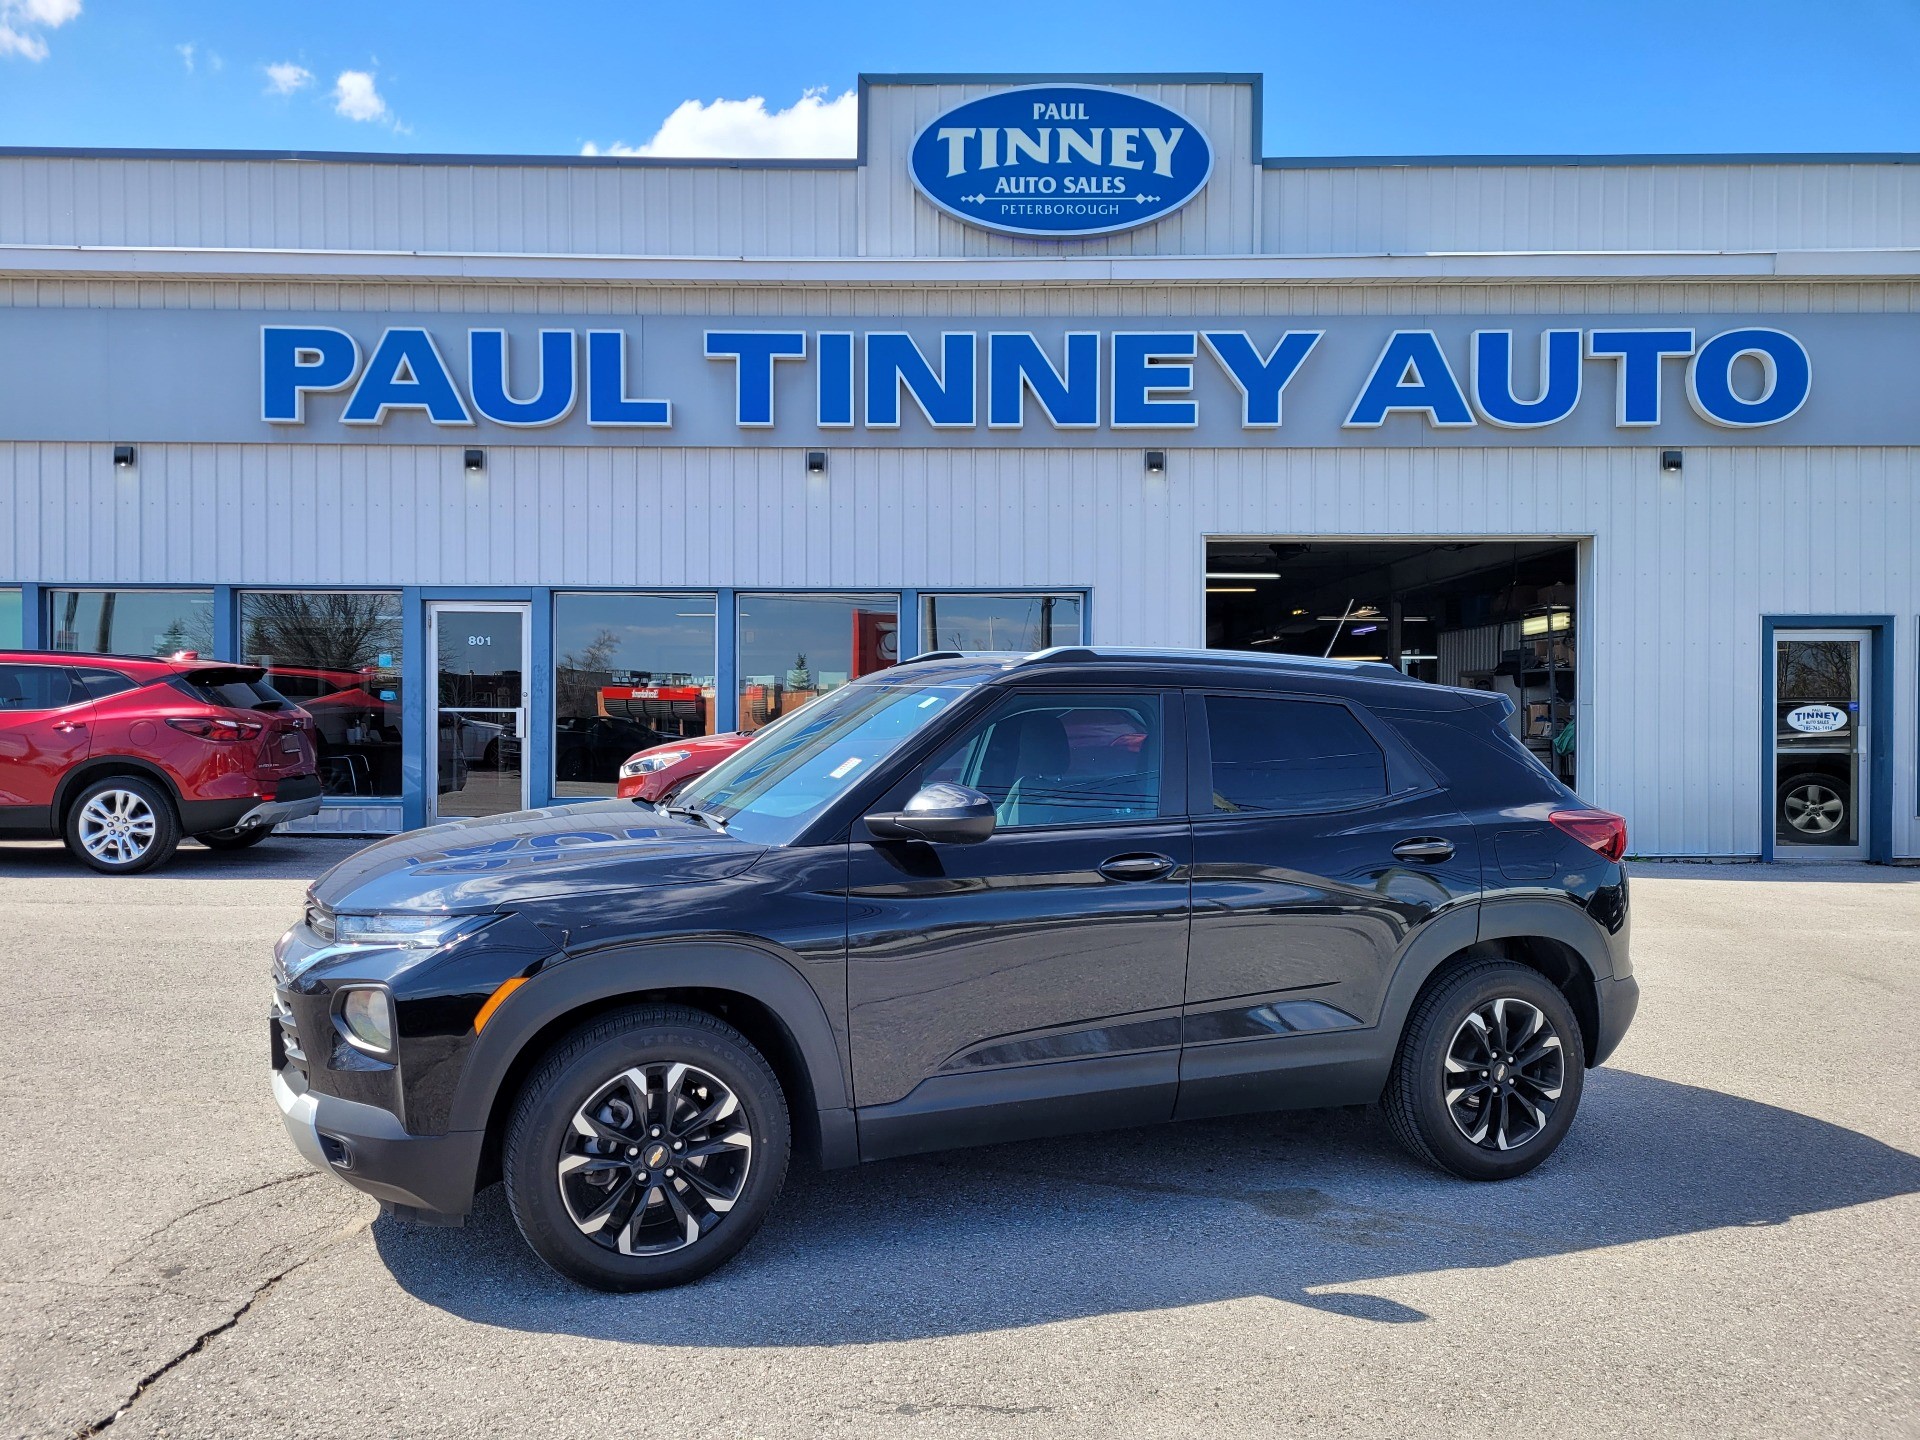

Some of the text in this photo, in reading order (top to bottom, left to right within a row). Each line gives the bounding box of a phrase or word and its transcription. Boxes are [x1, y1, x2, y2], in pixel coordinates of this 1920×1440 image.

[1033, 102, 1090, 121] PAUL
[936, 127, 1185, 179] TINNEY
[994, 176, 1127, 194] AUTO SALES
[1001, 203, 1120, 216] PETERBOROUGH
[260, 324, 1813, 430] PAUL TINNEY AUTO
[467, 635, 491, 646] 801
[1795, 712, 1839, 721] TINNEY
